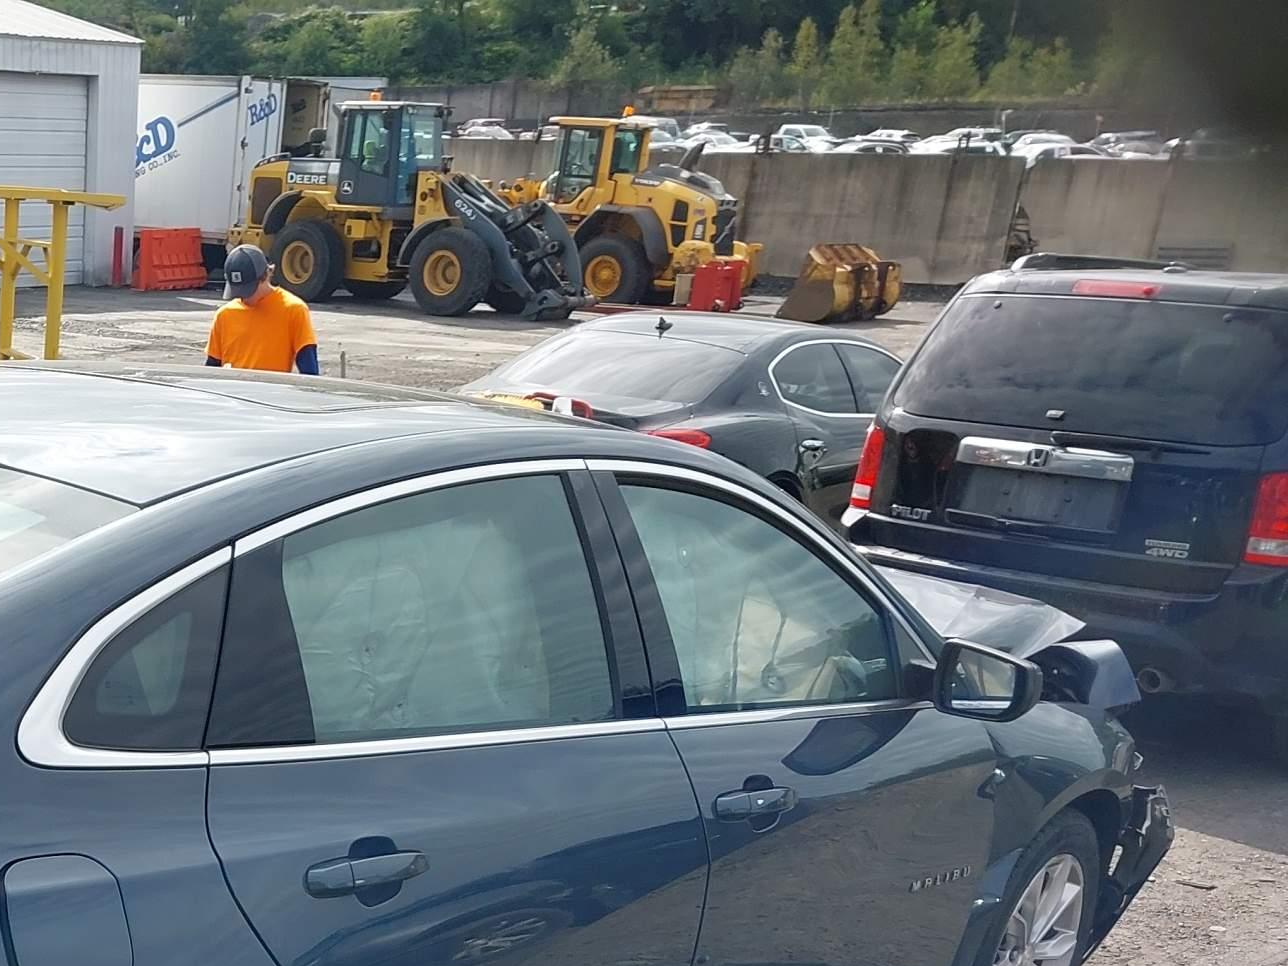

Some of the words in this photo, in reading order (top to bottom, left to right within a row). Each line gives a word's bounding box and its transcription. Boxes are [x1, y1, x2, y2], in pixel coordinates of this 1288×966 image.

[247, 93, 278, 126] R&D
[287, 172, 327, 185] DEERE
[891, 504, 931, 520] PILOT
[1145, 548, 1188, 559] 4WD
[910, 865, 971, 891] MALIBU
